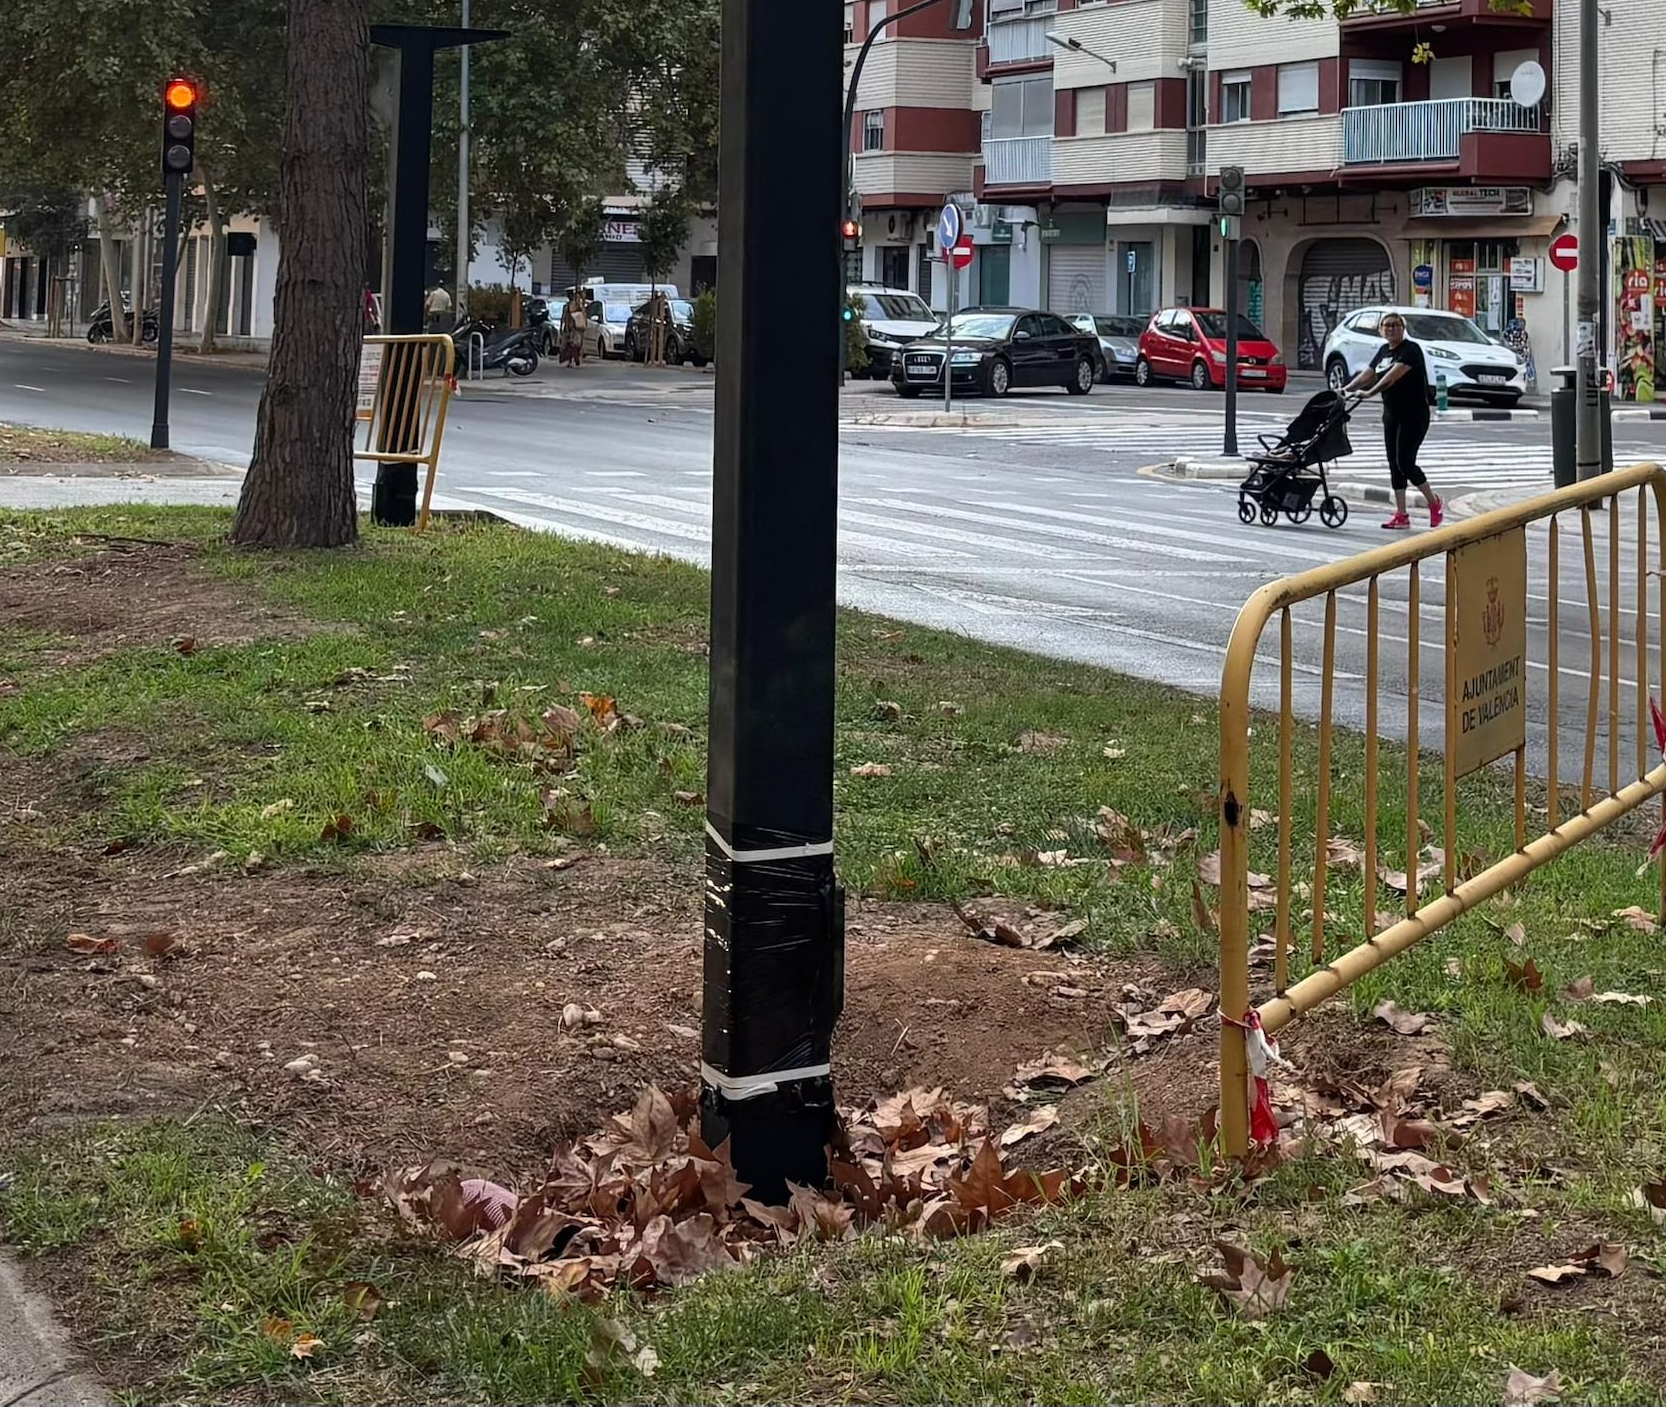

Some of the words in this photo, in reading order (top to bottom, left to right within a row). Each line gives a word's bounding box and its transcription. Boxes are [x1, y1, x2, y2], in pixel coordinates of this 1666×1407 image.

[1628, 271, 1648, 287] ria
[1461, 655, 1521, 703] AJUNTAMENT
[1462, 708, 1476, 734] DE
